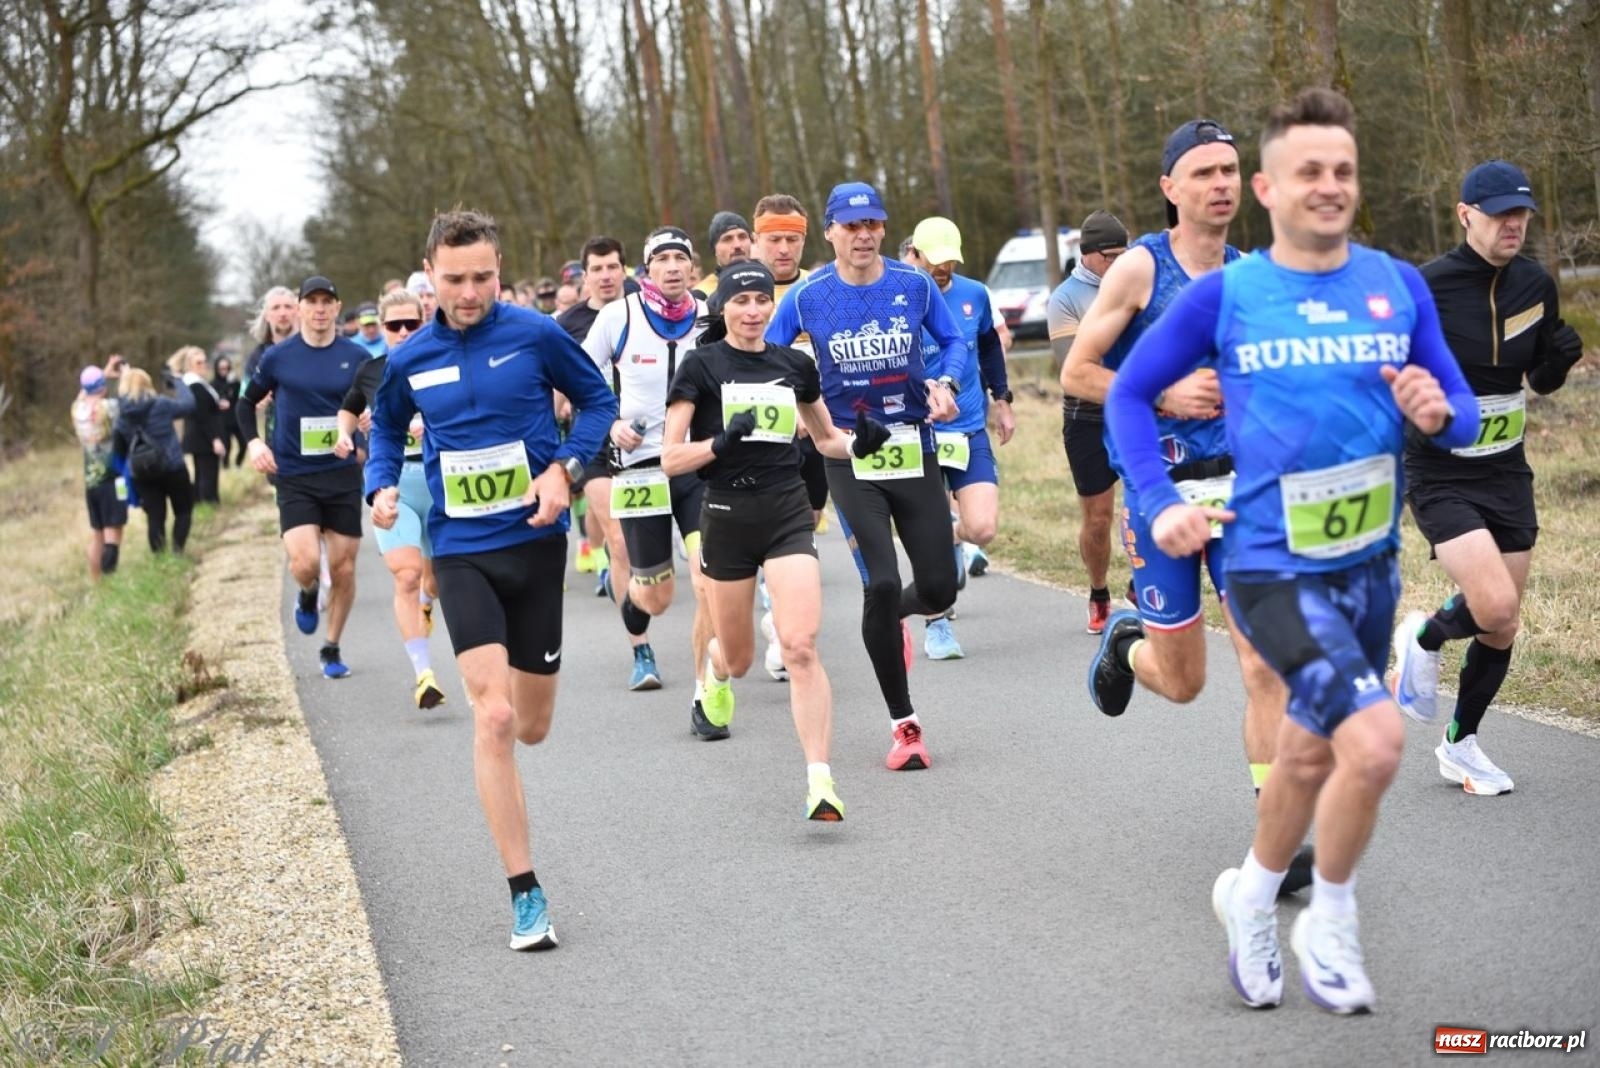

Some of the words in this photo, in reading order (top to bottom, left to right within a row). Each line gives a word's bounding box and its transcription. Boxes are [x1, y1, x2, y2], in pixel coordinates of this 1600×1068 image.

[832, 336, 910, 361] SILESIAN
[1235, 333, 1411, 374] RUNNERS
[839, 359, 886, 374] TRIATHLON
[888, 355, 909, 369] TEAM
[1476, 415, 1509, 445] 72
[871, 445, 904, 470] 53
[457, 468, 516, 504] 107
[623, 486, 652, 509] 22
[1323, 493, 1371, 539] 67
